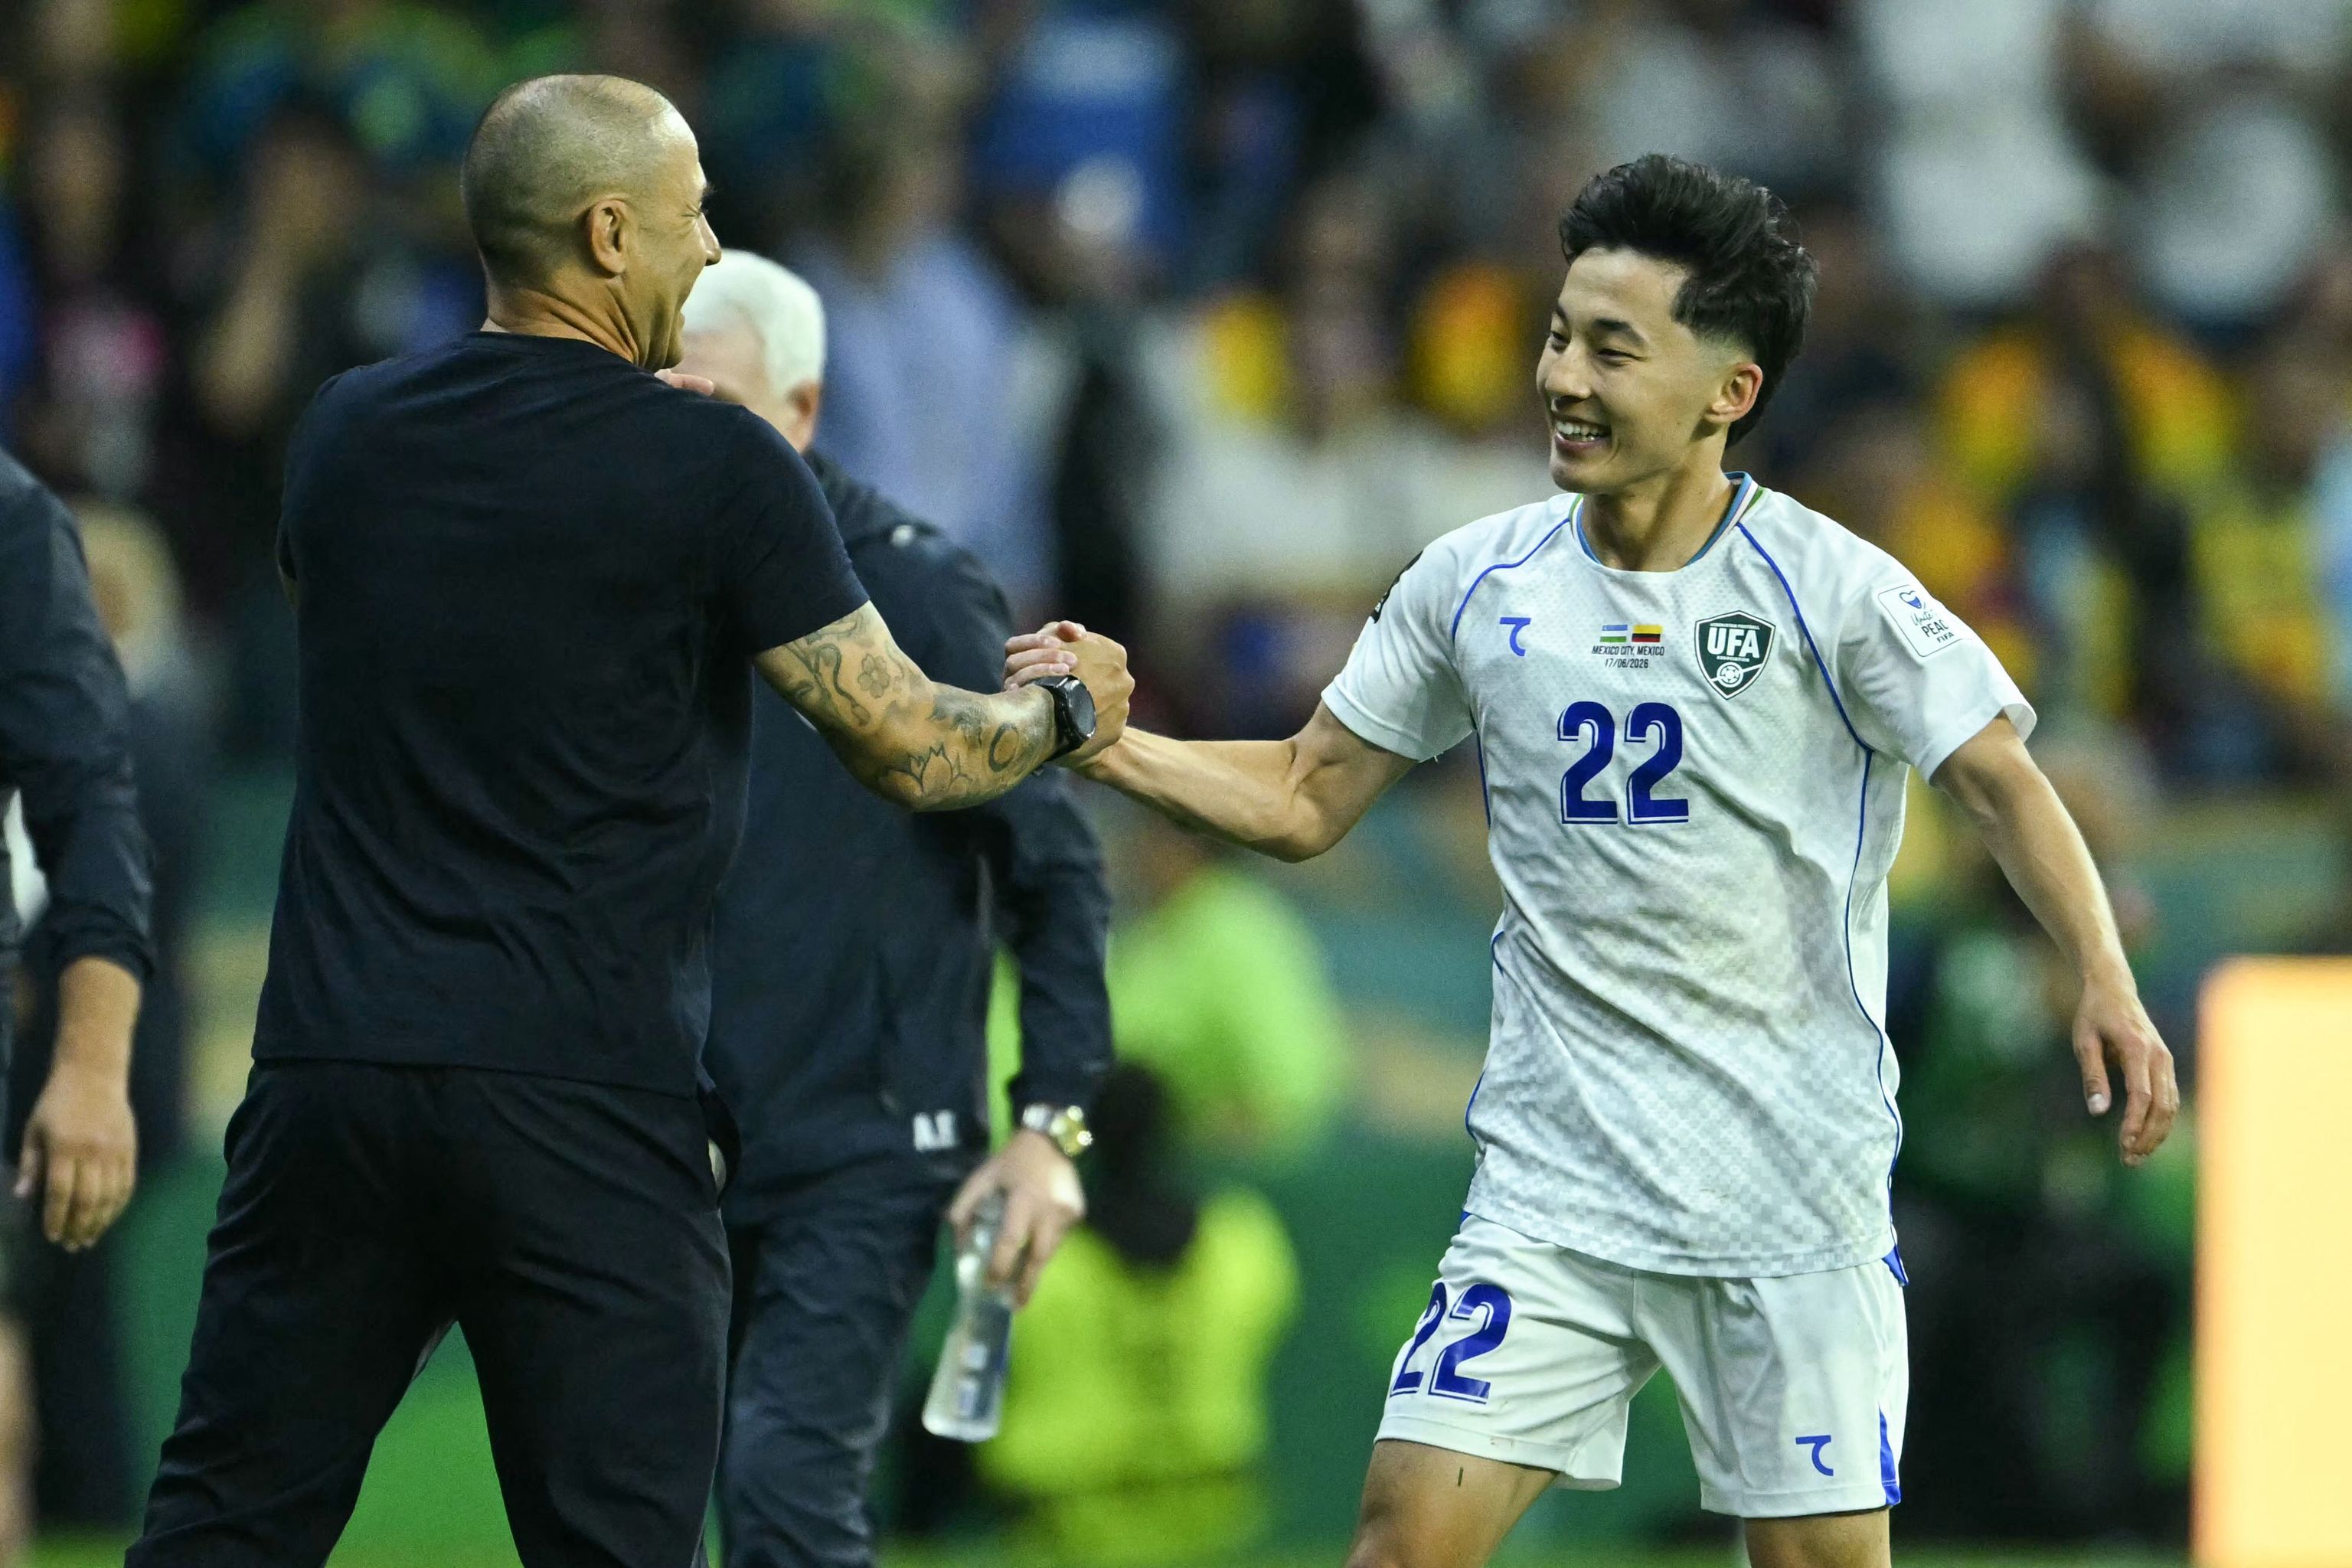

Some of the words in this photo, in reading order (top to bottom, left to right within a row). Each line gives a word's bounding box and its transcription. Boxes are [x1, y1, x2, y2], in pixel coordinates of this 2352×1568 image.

[1921, 619, 1949, 637] PEAC
[1936, 632, 1955, 642] FIFA
[1592, 645, 1619, 655] MEXICO
[1620, 645, 1635, 656] CITY,
[1637, 646, 1665, 656] MEXICO
[1707, 626, 1760, 658] UFA
[1605, 658, 1649, 668] 17/06/2026
[1557, 701, 1689, 825] 22
[1390, 1282, 1512, 1405] 22
